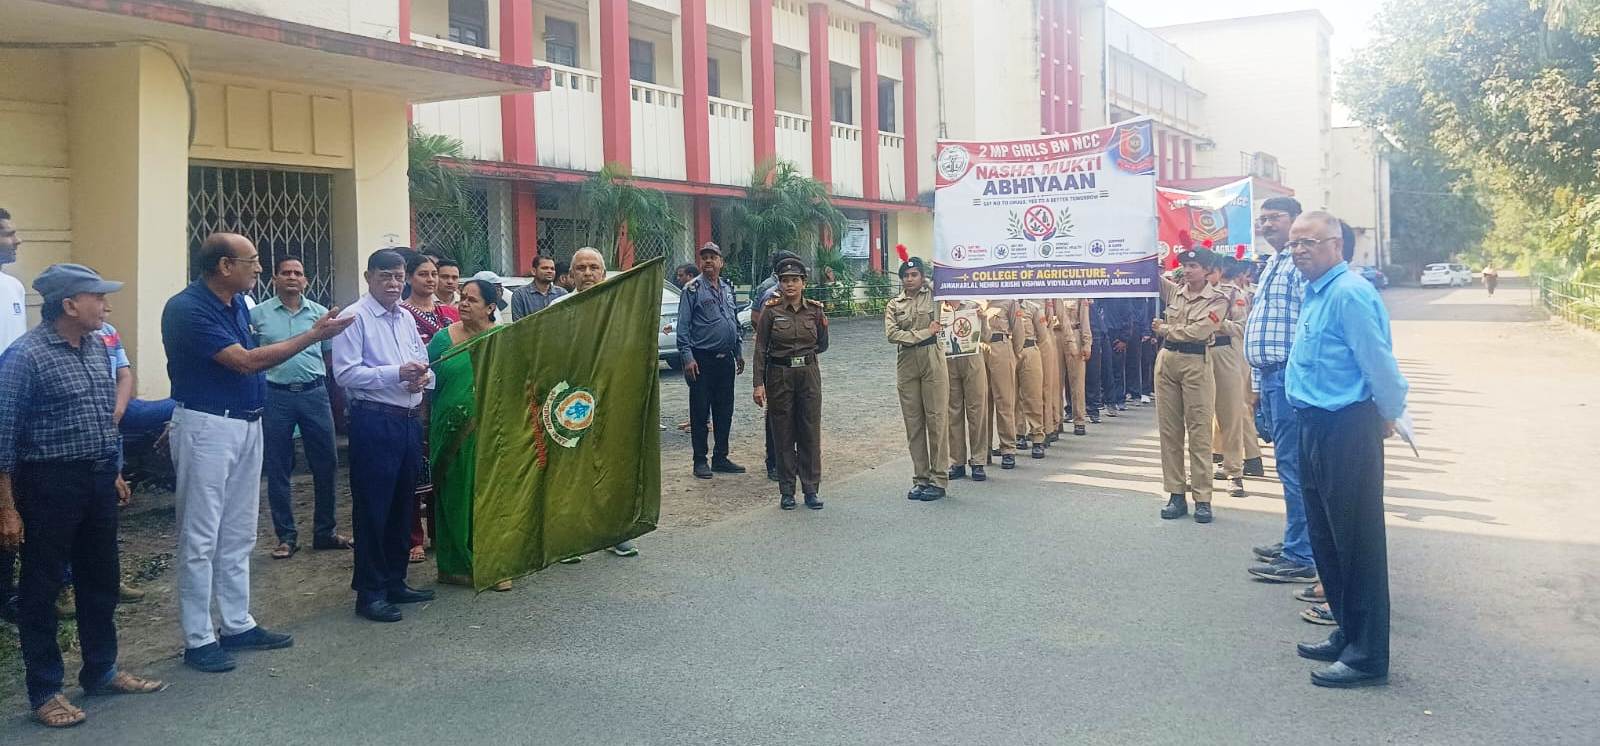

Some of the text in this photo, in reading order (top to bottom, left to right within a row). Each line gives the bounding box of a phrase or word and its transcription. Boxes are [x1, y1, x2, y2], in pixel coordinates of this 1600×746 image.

[979, 134, 1101, 157] 2 MP GIRLS BN NCC
[976, 164, 1035, 180] NASHA
[1042, 157, 1102, 174] MUKTI
[982, 173, 1096, 196] ABHIYAAN
[940, 281, 979, 290] JAWAHARLAL
[979, 281, 1000, 289] NEHRU
[1021, 280, 1046, 288] VISHWA
[1047, 279, 1082, 287] VIDYALAYA
[1111, 278, 1140, 286] JABALPUR
[1141, 277, 1151, 285] MP
[972, 271, 1018, 281] COLLEGE
[1020, 270, 1034, 280] OF
